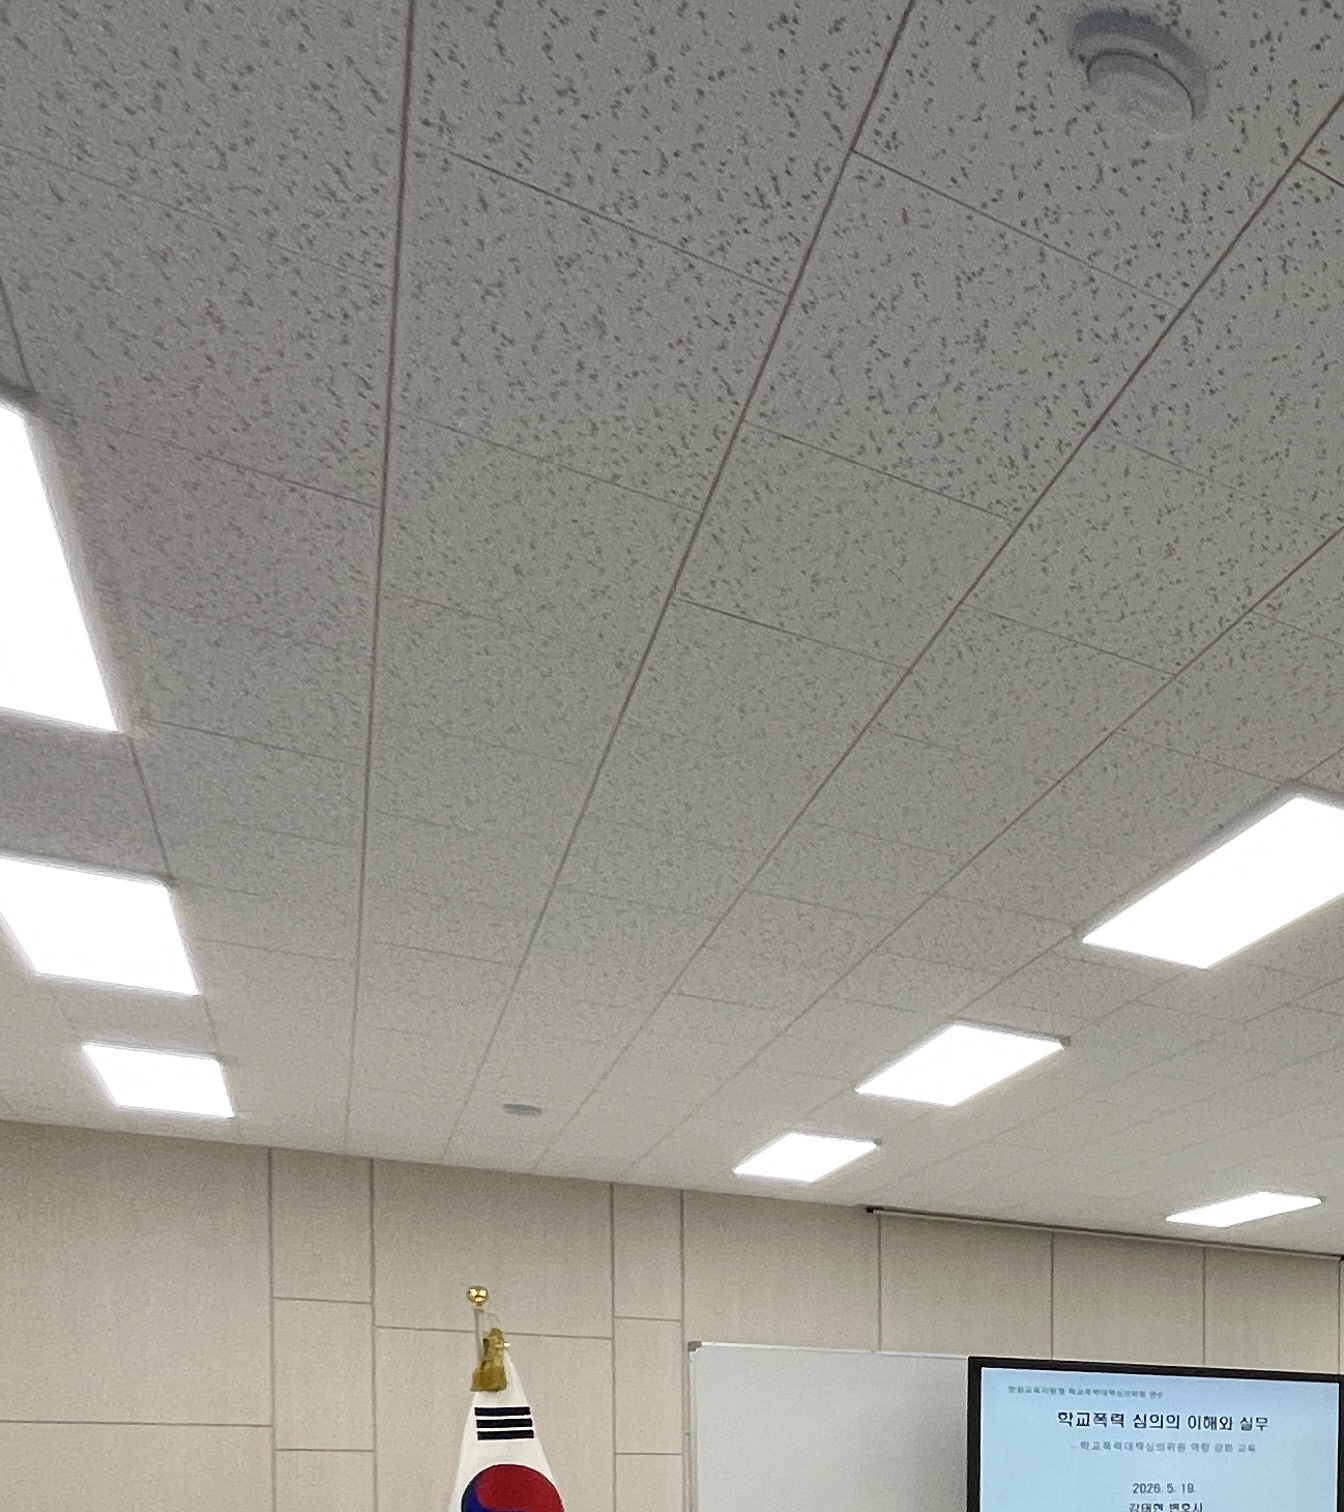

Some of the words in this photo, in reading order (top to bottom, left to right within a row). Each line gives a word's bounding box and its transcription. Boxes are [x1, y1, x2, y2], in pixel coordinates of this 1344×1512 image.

[1057, 1411, 1125, 1428] 학교폭력
[1133, 1413, 1181, 1430] 심의의
[1187, 1415, 1233, 1431] 이해와
[1240, 1416, 1269, 1432] 실무
